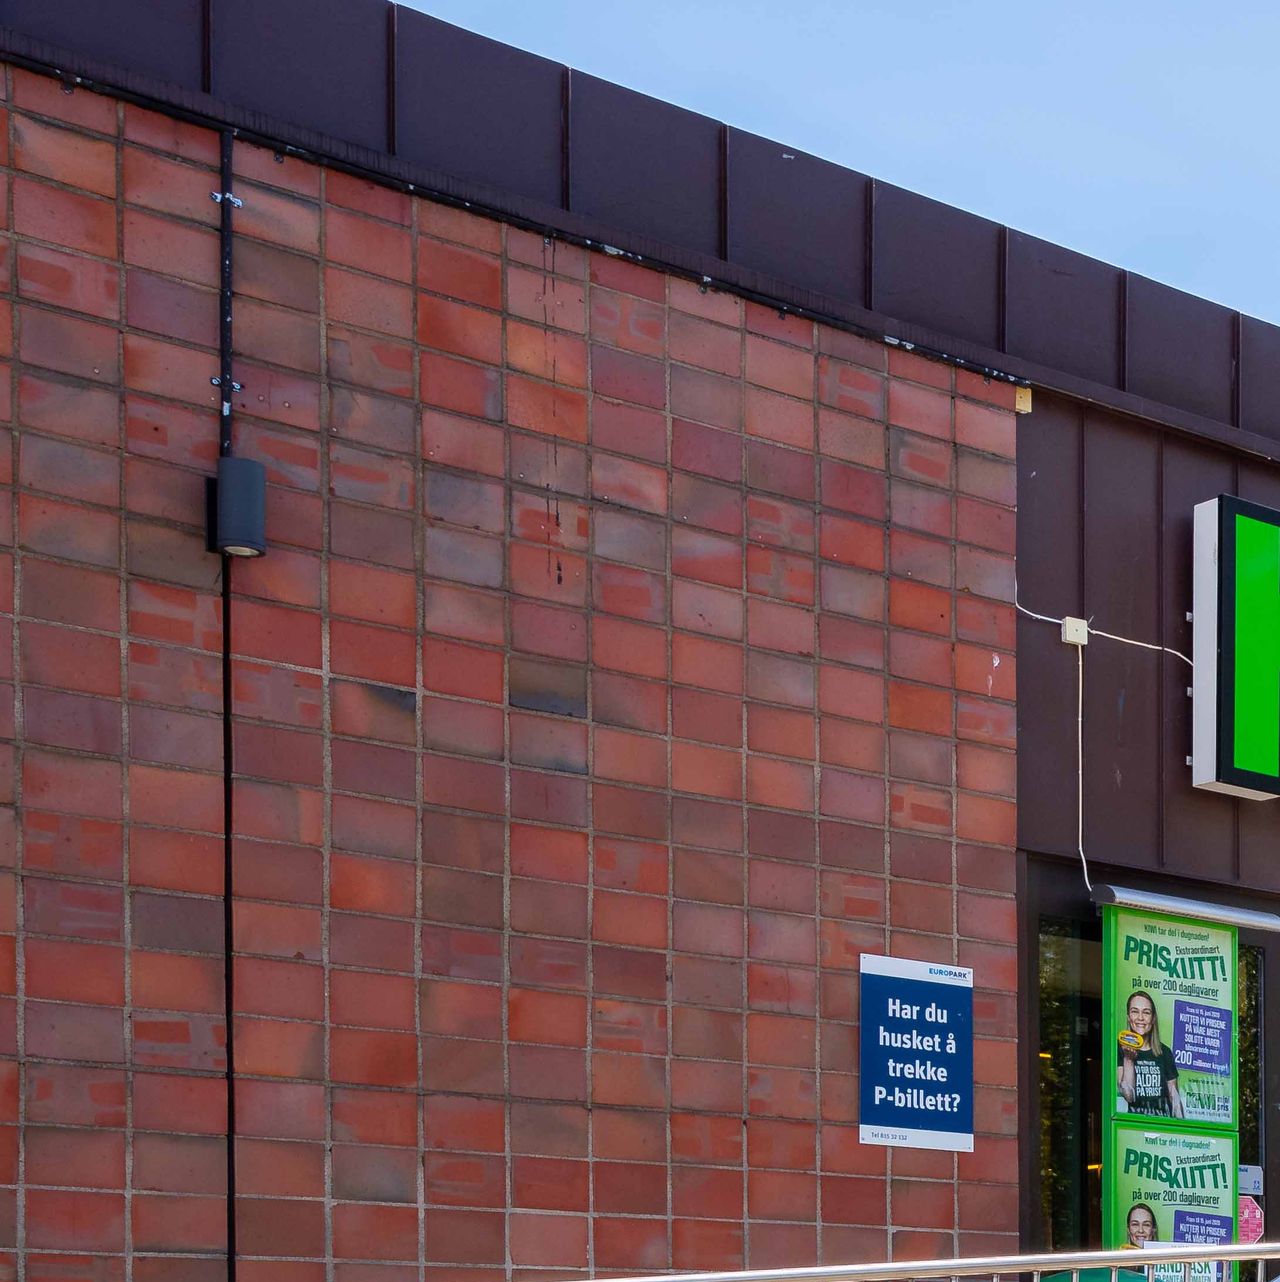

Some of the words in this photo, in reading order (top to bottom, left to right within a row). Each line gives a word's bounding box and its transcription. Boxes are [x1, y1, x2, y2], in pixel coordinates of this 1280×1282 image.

[1158, 926, 1166, 935] tar
[1168, 928, 1177, 938] del
[1175, 945, 1220, 956] Ekstraordinært
[929, 967, 967, 979] EUROPARK
[1132, 976, 1142, 988] på
[1144, 979, 1161, 990] over
[1163, 979, 1178, 992] 200
[1179, 982, 1219, 997] dagligvarer
[888, 998, 920, 1020] Har
[925, 1003, 948, 1024] du
[1180, 1013, 1199, 1024] KUTTER
[1206, 1018, 1226, 1030] PRISENE
[879, 1026, 941, 1052] husket
[945, 1032, 956, 1054] å
[1175, 1050, 1192, 1065] 200
[888, 1058, 948, 1082] trekke
[1136, 1074, 1161, 1087] ALDRI
[874, 1085, 960, 1113] P-billett?
[871, 1131, 879, 1139] Tel
[1169, 1138, 1177, 1147] del
[1176, 1153, 1221, 1165] Ekstraordinært
[1132, 1188, 1142, 1201] på
[1144, 1191, 1161, 1201] over
[1163, 1191, 1177, 1202] 200
[1179, 1191, 1220, 1206] dagligvarer
[1180, 1223, 1199, 1234] KUTTER
[1206, 1226, 1227, 1237] PRISENE
